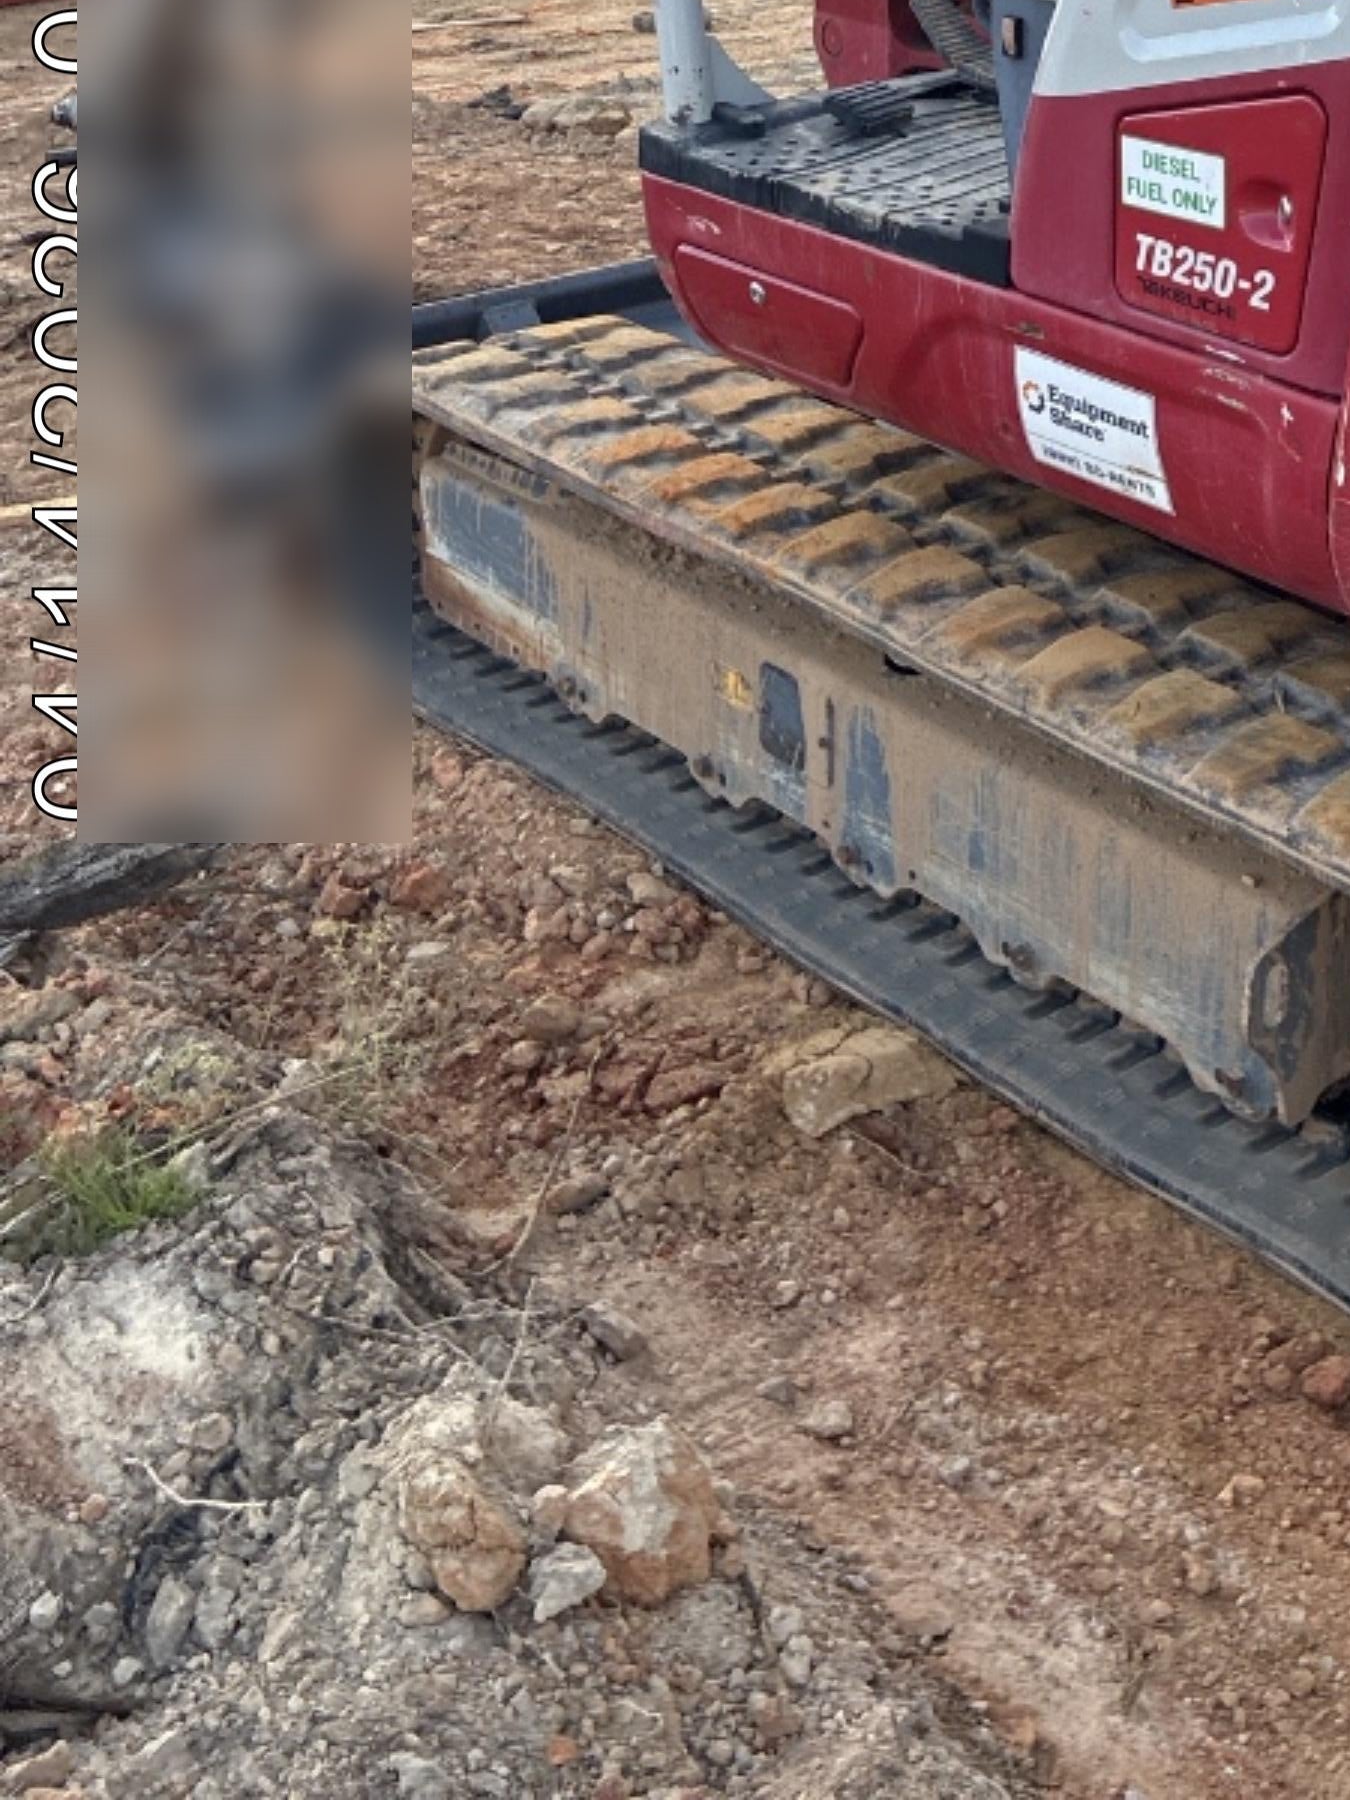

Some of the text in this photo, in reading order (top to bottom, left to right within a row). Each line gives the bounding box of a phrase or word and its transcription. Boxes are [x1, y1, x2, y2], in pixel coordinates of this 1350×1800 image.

[1141, 149, 1201, 182] DIESEL
[1126, 176, 1218, 217] FUEL ONLY
[1135, 232, 1276, 311] TB250-2
[1046, 382, 1150, 440] Equipment
[1049, 406, 1105, 443] Share
